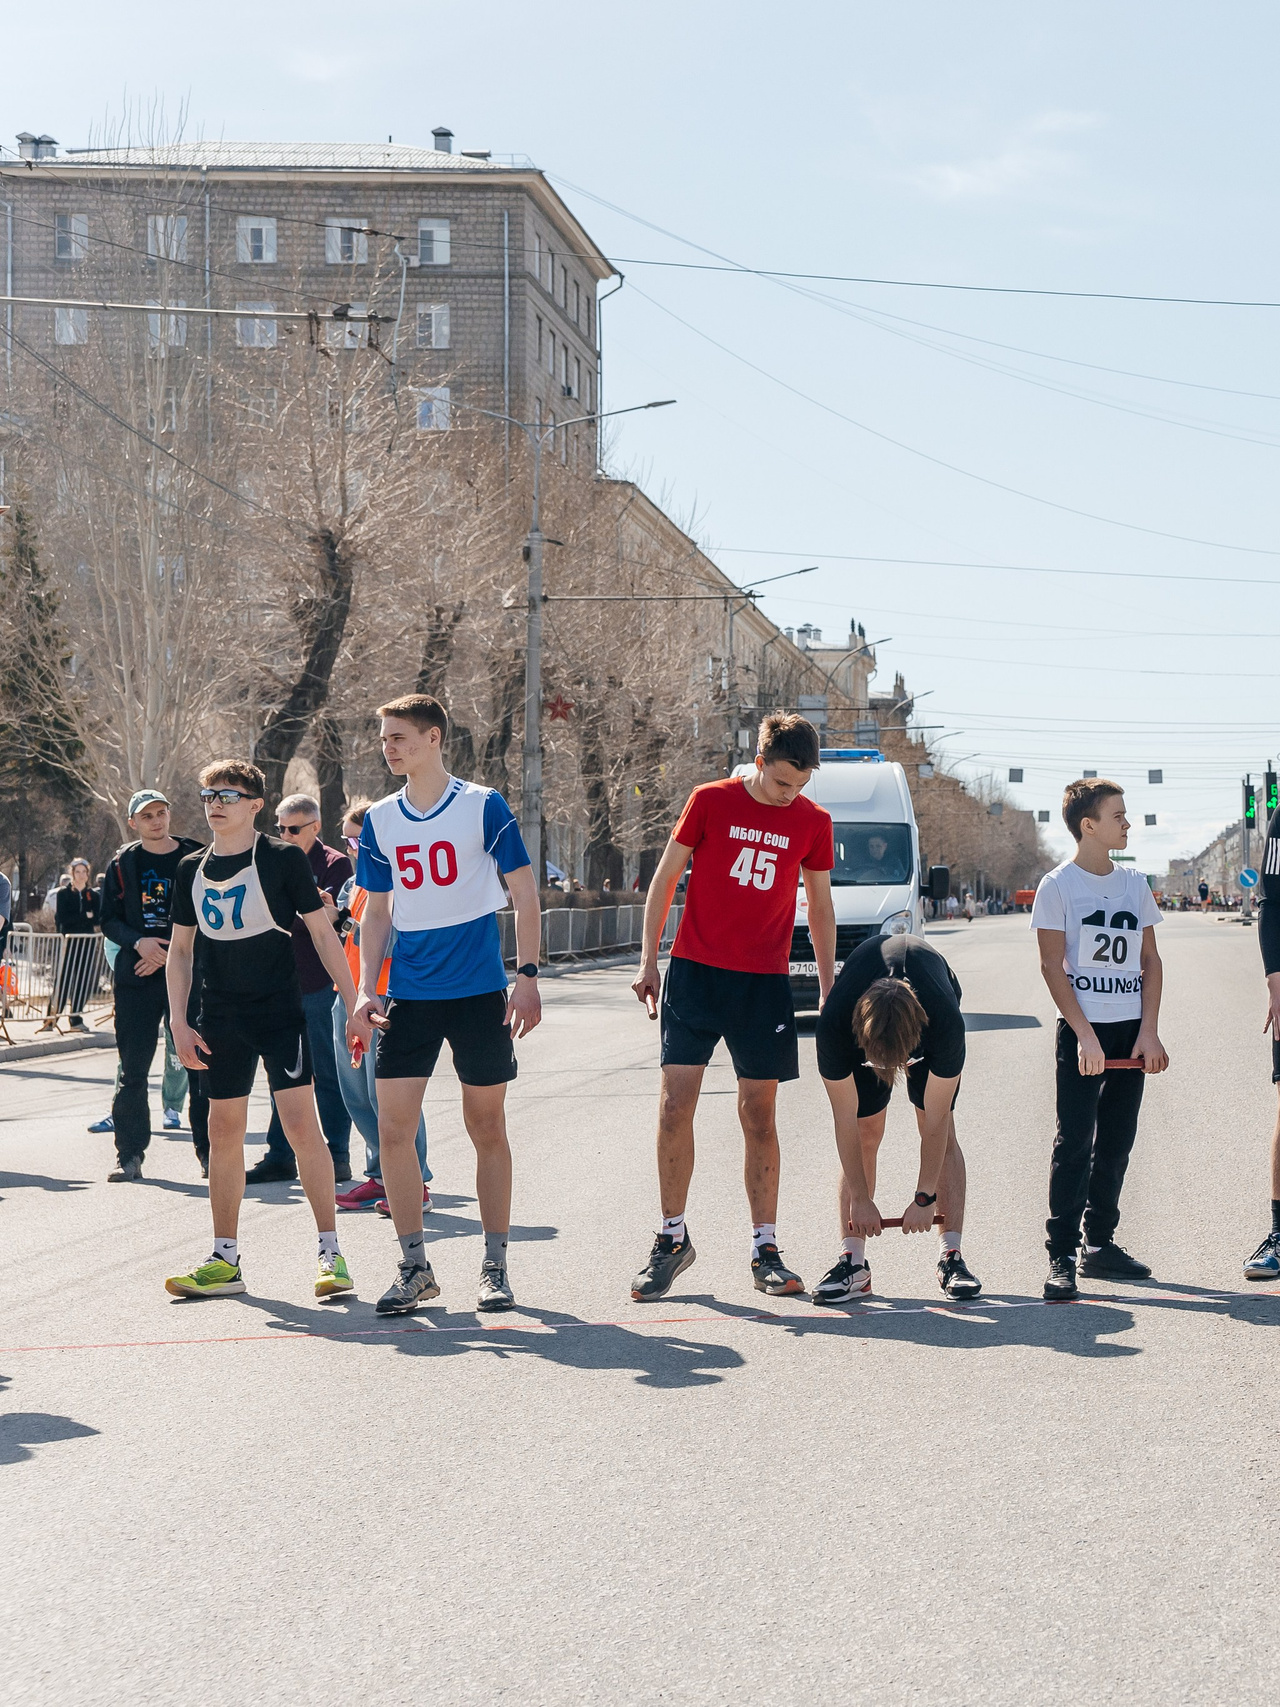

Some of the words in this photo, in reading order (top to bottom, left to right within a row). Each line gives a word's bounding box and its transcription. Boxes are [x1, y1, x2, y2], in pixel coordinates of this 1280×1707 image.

[729, 825, 763, 843] МБОУ
[763, 832, 790, 850] СОШ
[395, 840, 459, 890] 50
[729, 846, 779, 891] 45
[202, 884, 247, 930] 67
[1092, 933, 1128, 965] 20
